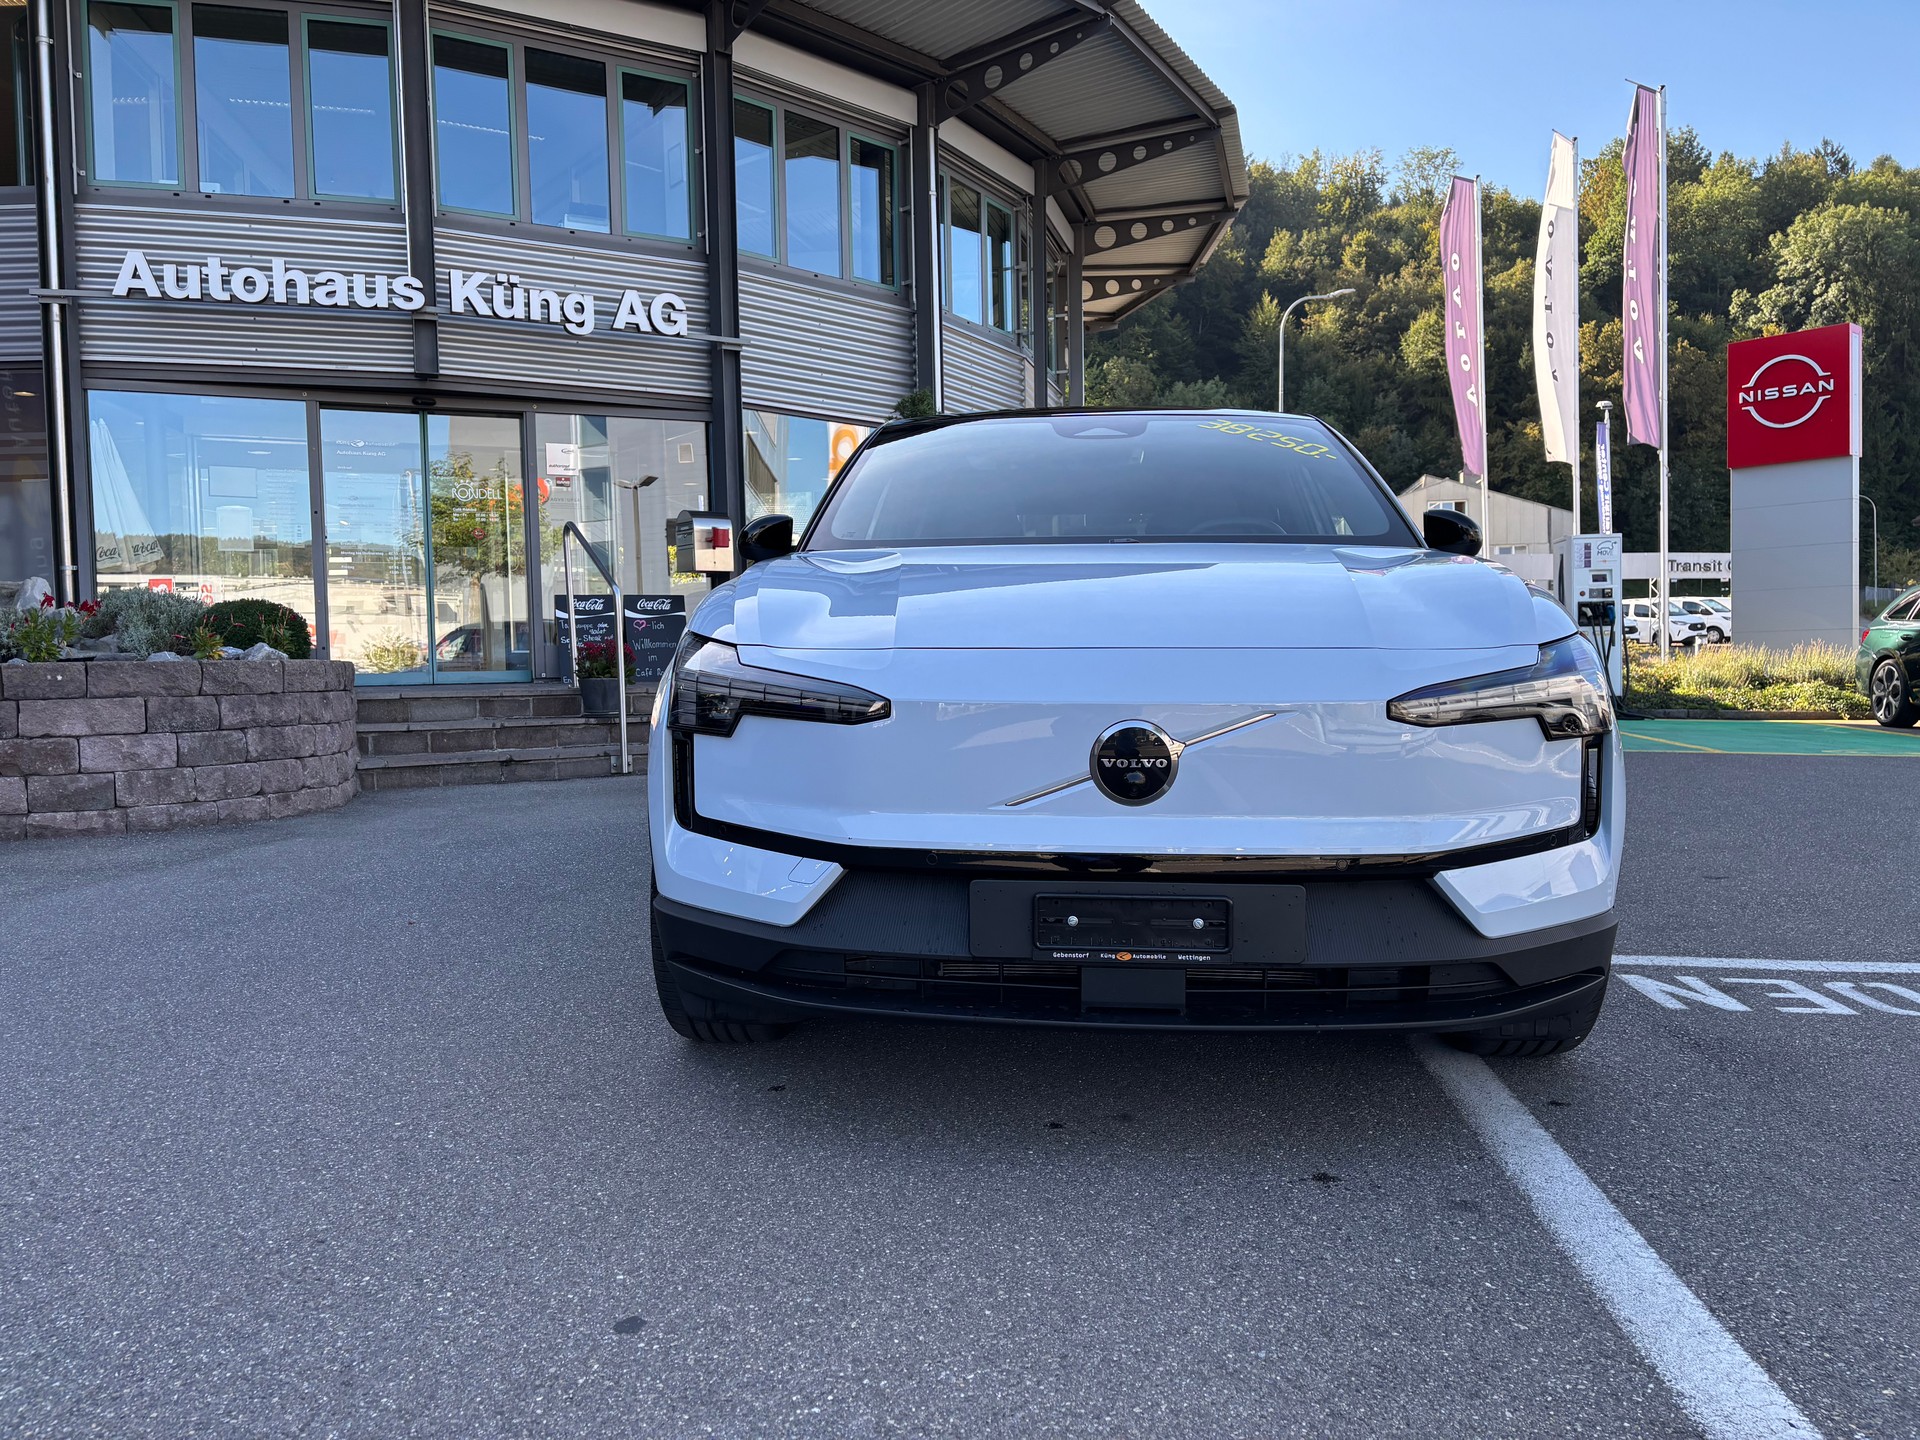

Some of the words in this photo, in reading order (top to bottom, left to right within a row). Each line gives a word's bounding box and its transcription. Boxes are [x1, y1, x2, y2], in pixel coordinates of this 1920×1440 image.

[111, 250, 425, 311] Autohaus
[448, 268, 596, 336] Küng
[611, 289, 689, 337] AG
[1739, 377, 1835, 405] NISSAN
[451, 487, 503, 501] RONDELL
[1667, 559, 1723, 572] Transit
[632, 638, 677, 651] Willkommen
[647, 652, 658, 662] im
[1101, 758, 1168, 768] VOLVO
